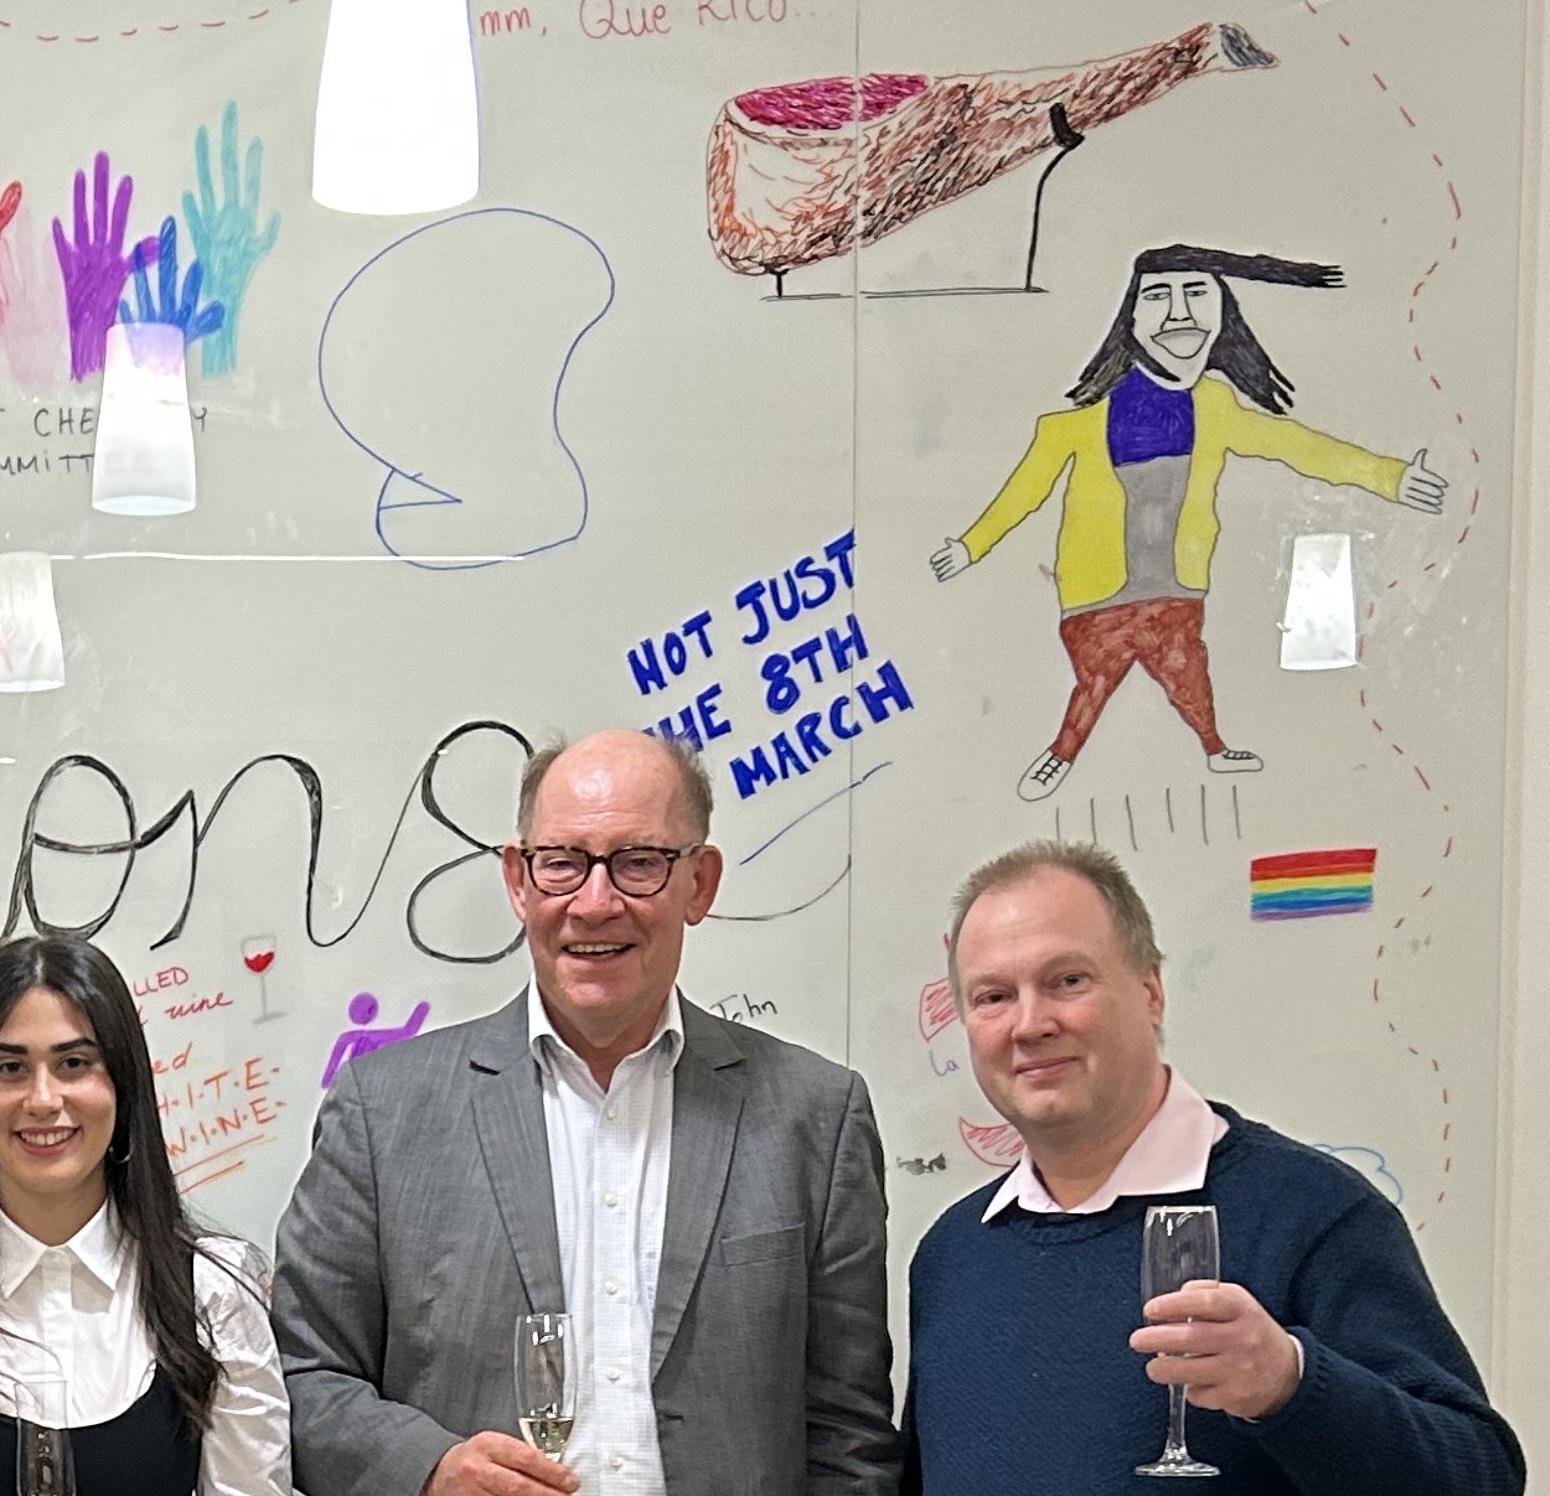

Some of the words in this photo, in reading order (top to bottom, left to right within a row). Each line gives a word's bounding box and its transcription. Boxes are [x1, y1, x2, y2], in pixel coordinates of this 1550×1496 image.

[580, 0, 672, 39] Que
[627, 609, 714, 696] NOT
[734, 527, 857, 645] JUST
[760, 611, 870, 716] 8TH
[729, 658, 915, 800] MARCH
[132, 966, 190, 998] LLED
[151, 1040, 193, 1076] ed
